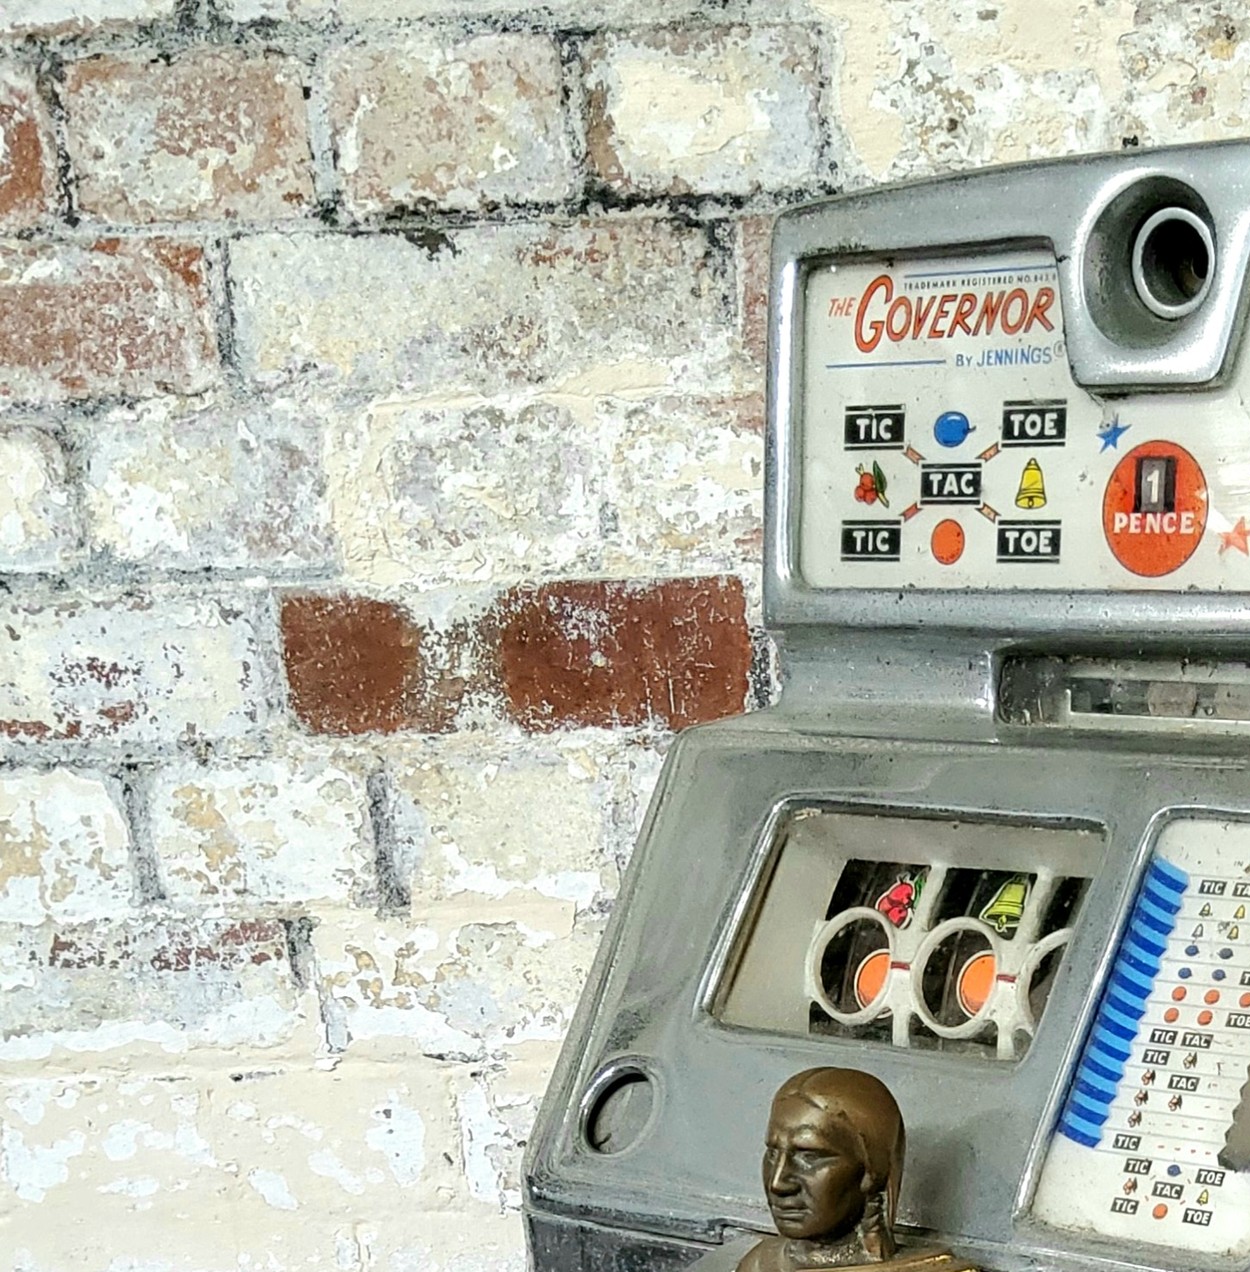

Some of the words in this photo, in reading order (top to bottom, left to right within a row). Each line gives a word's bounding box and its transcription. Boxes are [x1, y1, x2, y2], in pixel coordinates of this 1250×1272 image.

[961, 274, 1014, 287] REGISTERED
[828, 297, 855, 317] THE
[854, 273, 1055, 354] GOVERNOR
[856, 418, 892, 441] TIC
[1010, 413, 1057, 437] TOE
[929, 473, 973, 495] TAC
[1146, 469, 1160, 504] 1
[1113, 512, 1195, 534] PENCE
[852, 530, 890, 553] TIC
[1005, 530, 1052, 554] TOE
[1203, 882, 1223, 893] TIC
[1154, 1031, 1174, 1043] TIC
[1184, 1035, 1208, 1047] TAC
[1172, 1077, 1197, 1089] TAC
[1116, 1136, 1138, 1149] TIC
[1127, 1161, 1149, 1173] TIC
[1199, 1171, 1223, 1183] TOE
[1155, 1184, 1180, 1197] TAC
[1115, 1201, 1136, 1213] TIC
[1186, 1211, 1210, 1224] TOE
